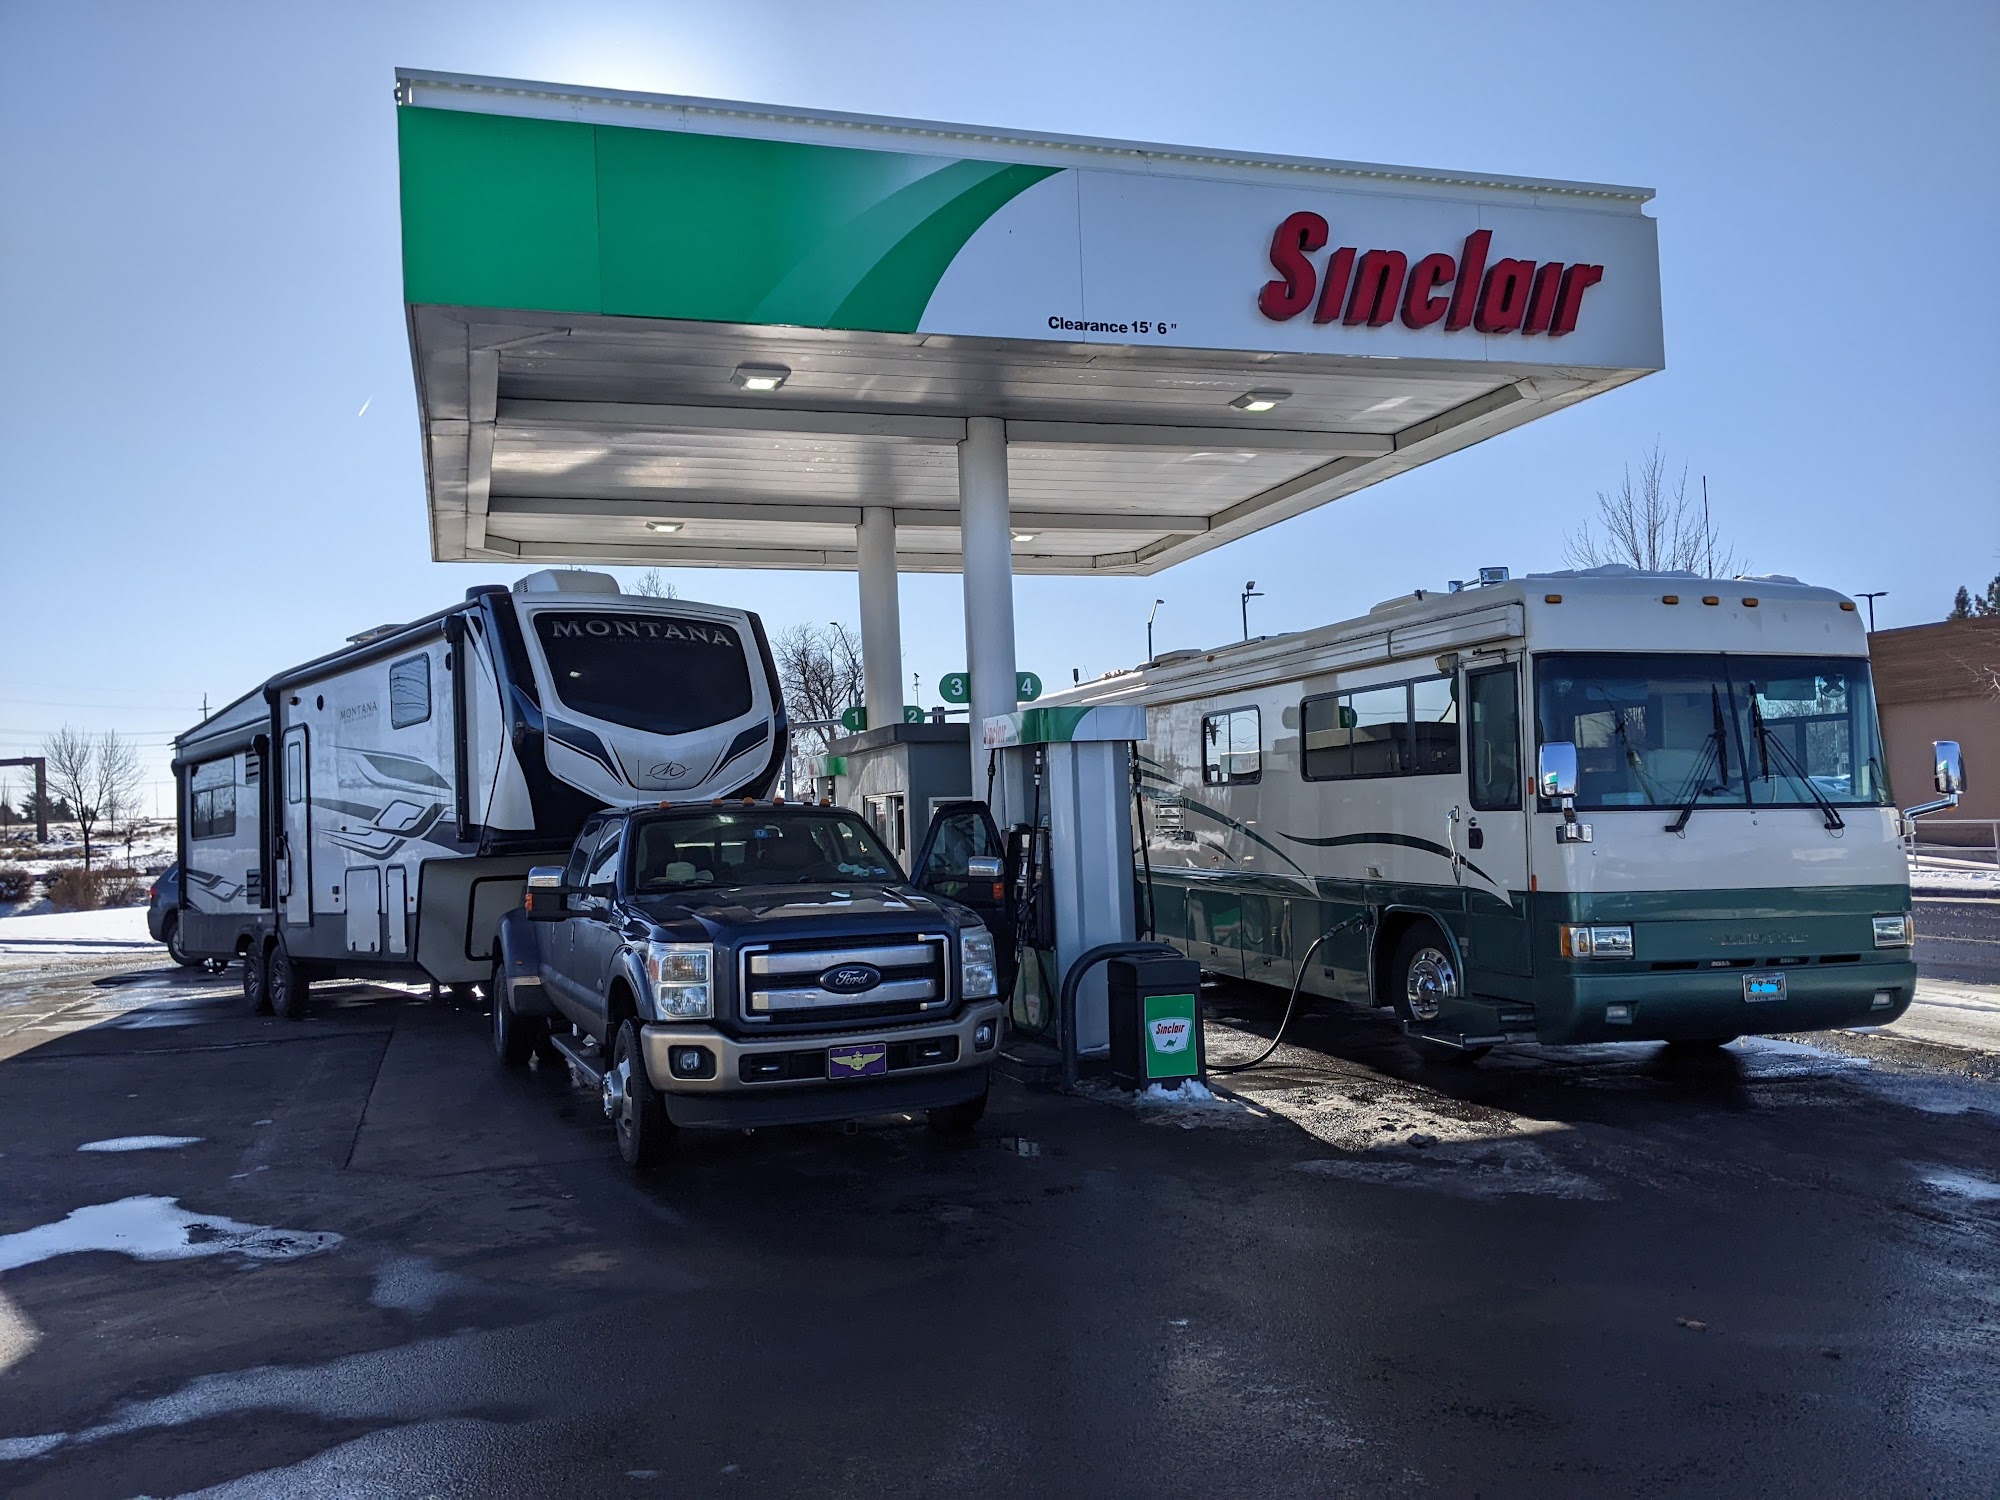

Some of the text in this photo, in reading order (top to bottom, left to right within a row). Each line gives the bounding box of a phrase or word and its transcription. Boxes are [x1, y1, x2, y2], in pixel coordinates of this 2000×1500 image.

[1258, 211, 1604, 336] Sinclair
[1048, 316, 1129, 333] Clearance
[1131, 320, 1153, 334] 15'
[552, 620, 734, 648] MONTANA
[951, 678, 963, 696] 3
[1021, 677, 1033, 696] 4
[340, 701, 378, 719] MONTANA
[851, 712, 859, 726] 1
[907, 709, 918, 723] 2
[835, 970, 869, 986] Ford
[1155, 1022, 1186, 1035] Sinclair
